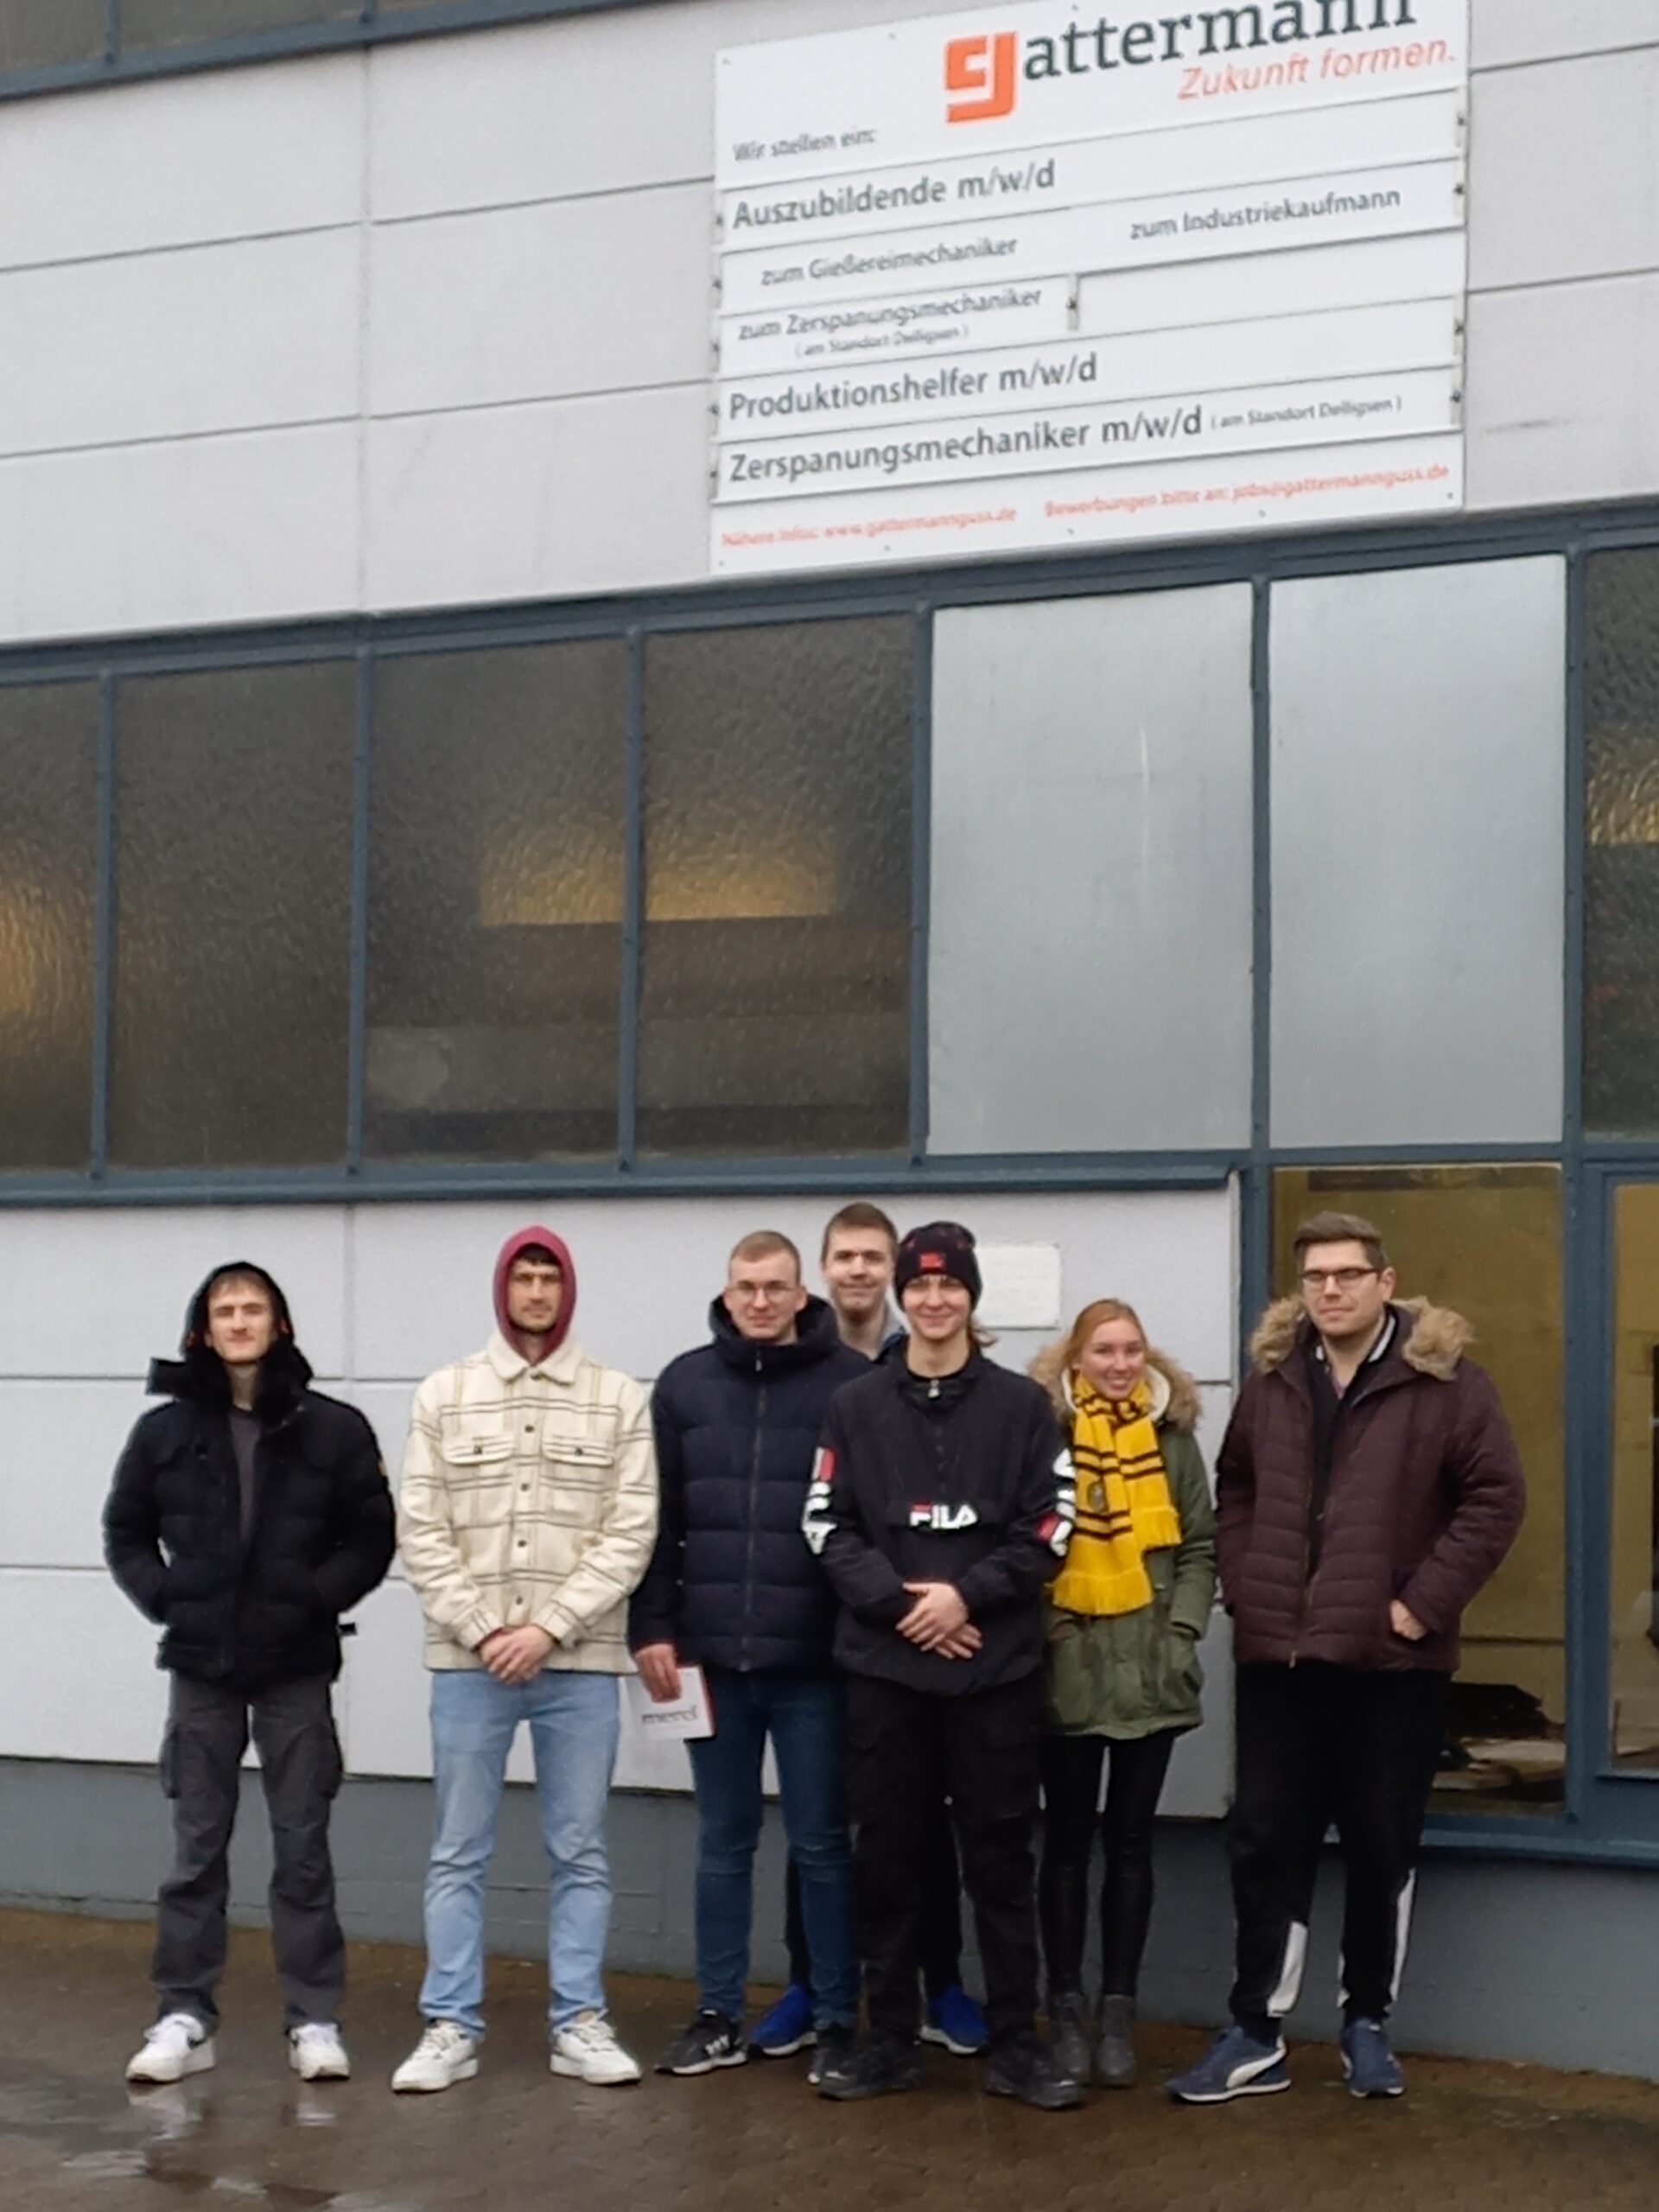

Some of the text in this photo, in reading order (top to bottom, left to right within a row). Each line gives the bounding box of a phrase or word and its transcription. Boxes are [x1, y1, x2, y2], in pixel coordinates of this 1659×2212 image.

[1179, 39, 1455, 99] Zukunft formen.
[733, 158, 1054, 228] Auszubildende m/w/d
[1129, 189, 1401, 240] zum Industriekaufmann
[787, 289, 1041, 334] Zerspanungsmechaniker
[730, 353, 1097, 419] Produktionshelfer m/w/d
[729, 423, 1091, 482] Zerspanungsmechaniker
[1101, 404, 1202, 443] m/w/d
[909, 1502, 978, 1530] FILA
